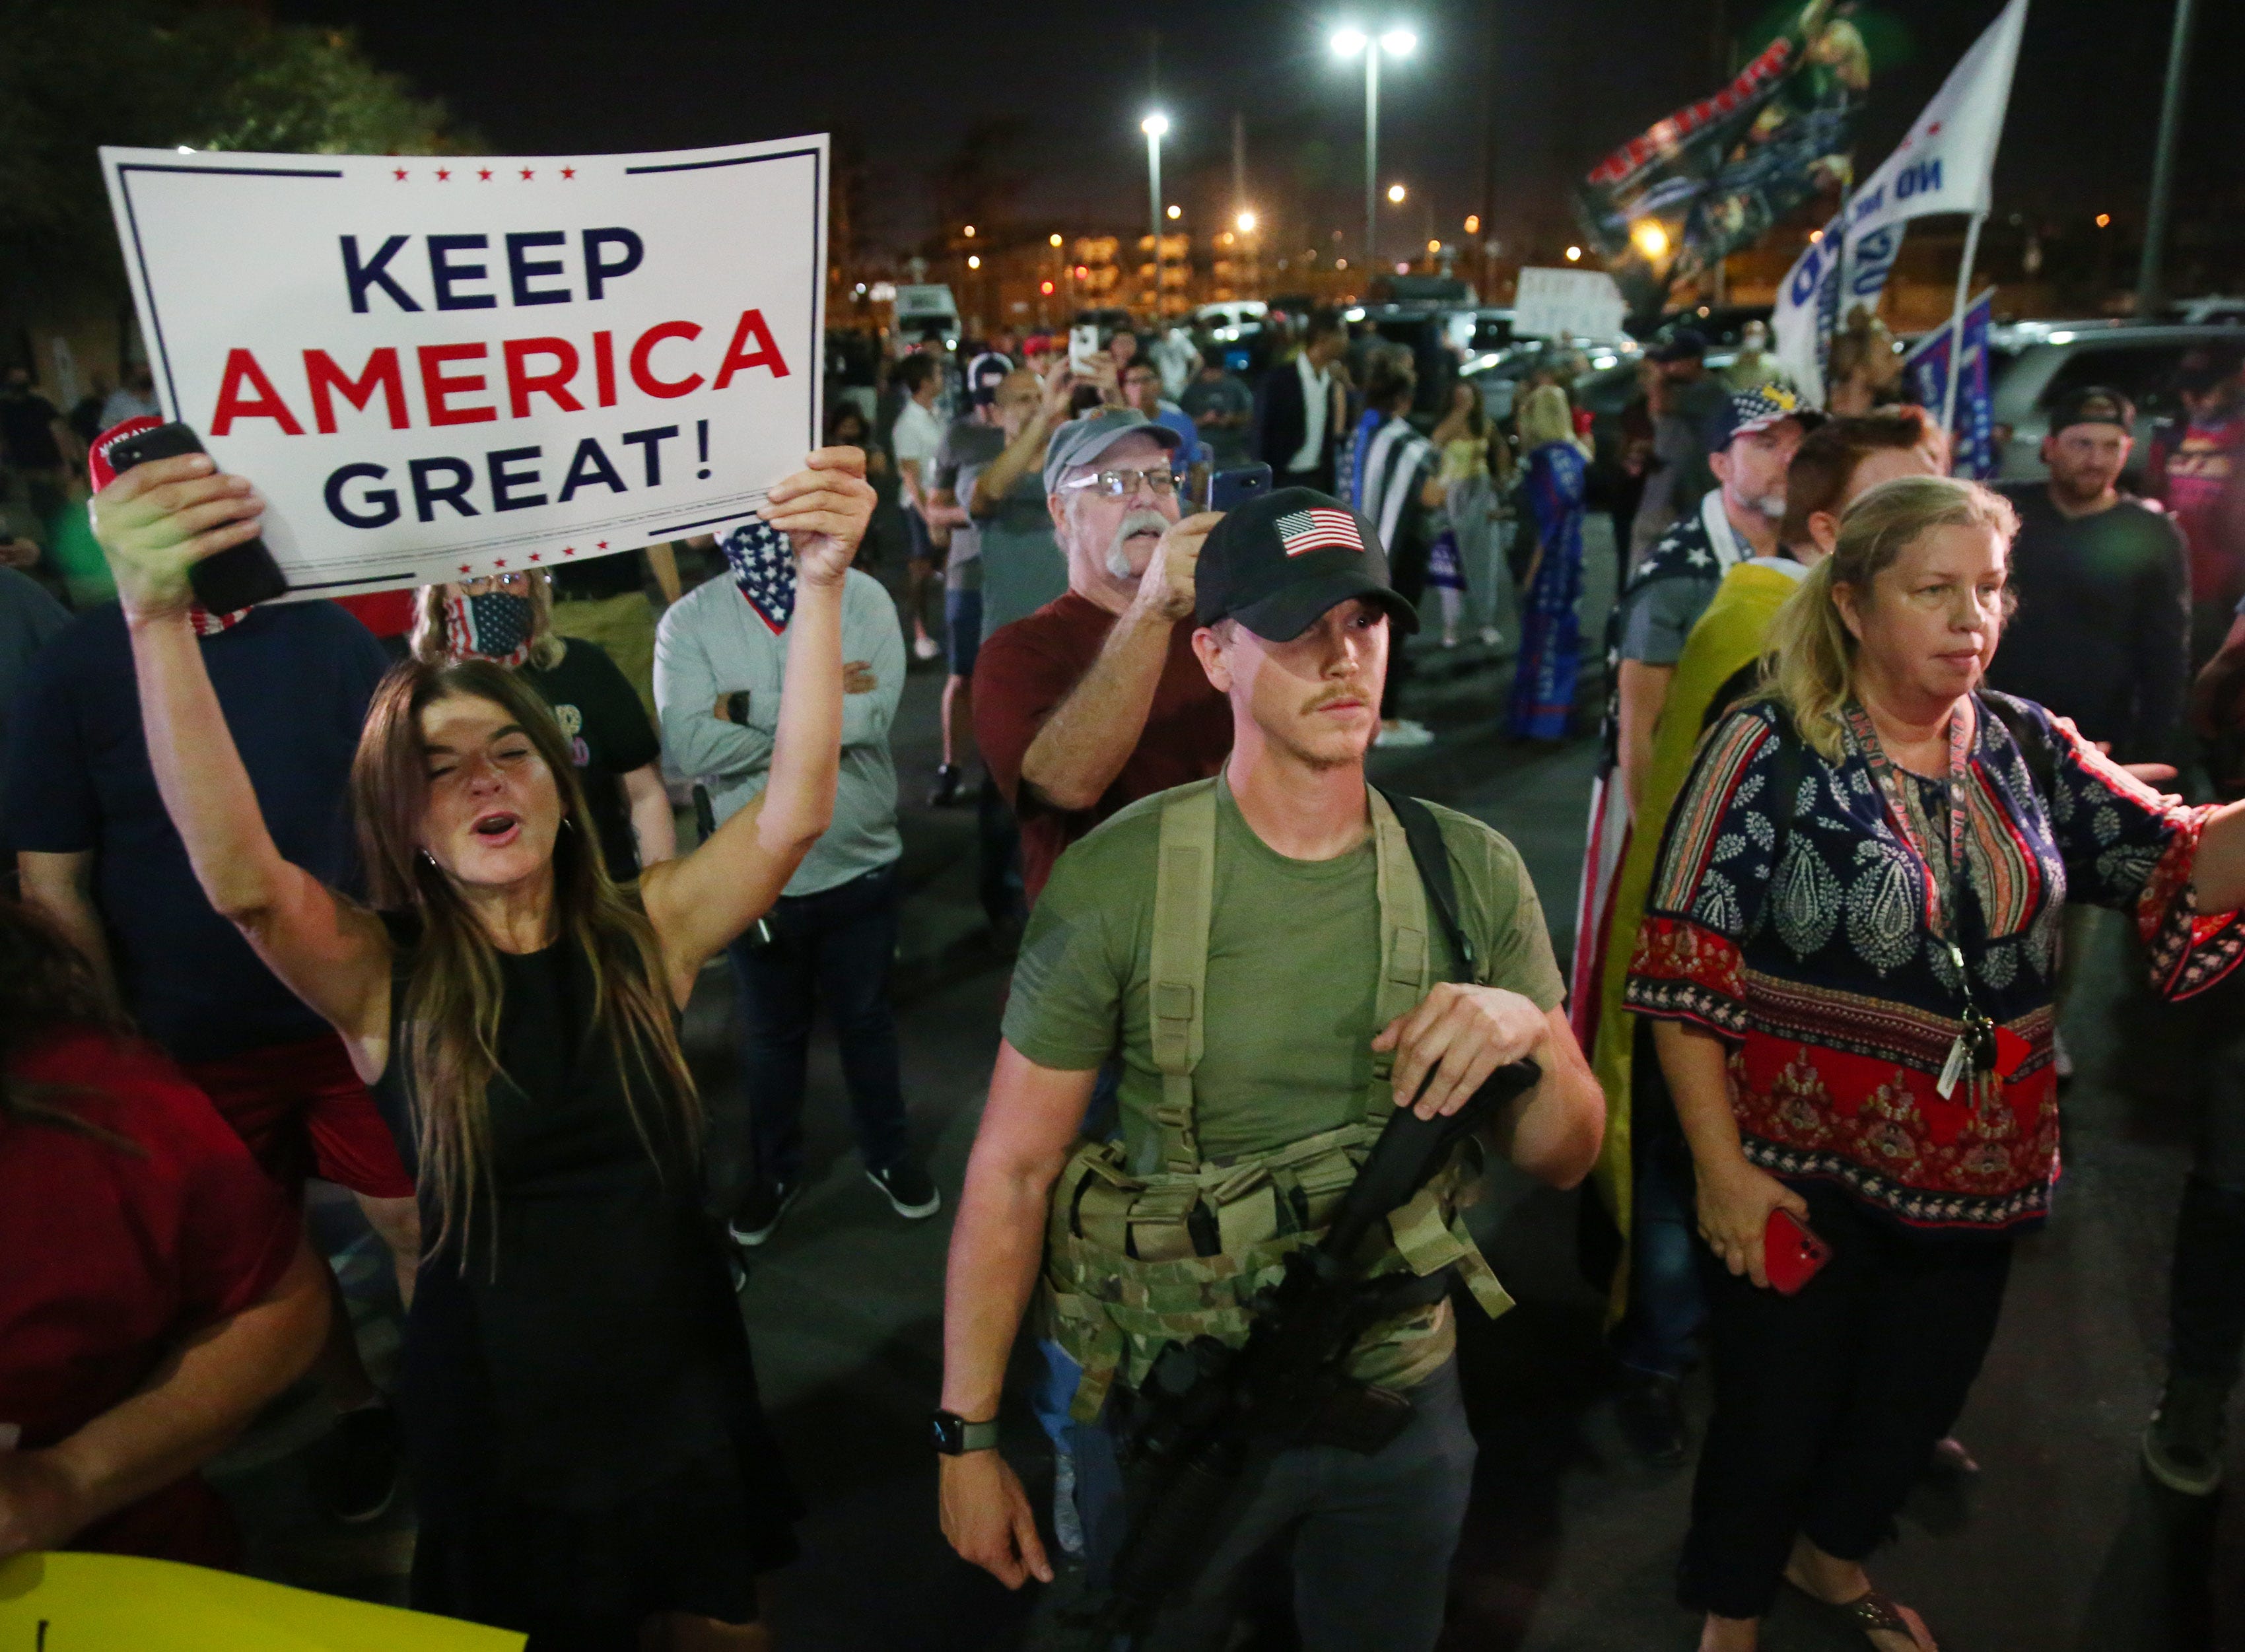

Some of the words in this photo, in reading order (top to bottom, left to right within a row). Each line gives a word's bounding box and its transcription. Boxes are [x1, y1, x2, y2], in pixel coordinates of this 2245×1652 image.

[340, 227, 644, 313] KEEP
[211, 308, 790, 436] AMERICA
[324, 419, 712, 528] GREAT!
[1848, 710, 1886, 769] USMC
[1951, 717, 1967, 780] USMC
